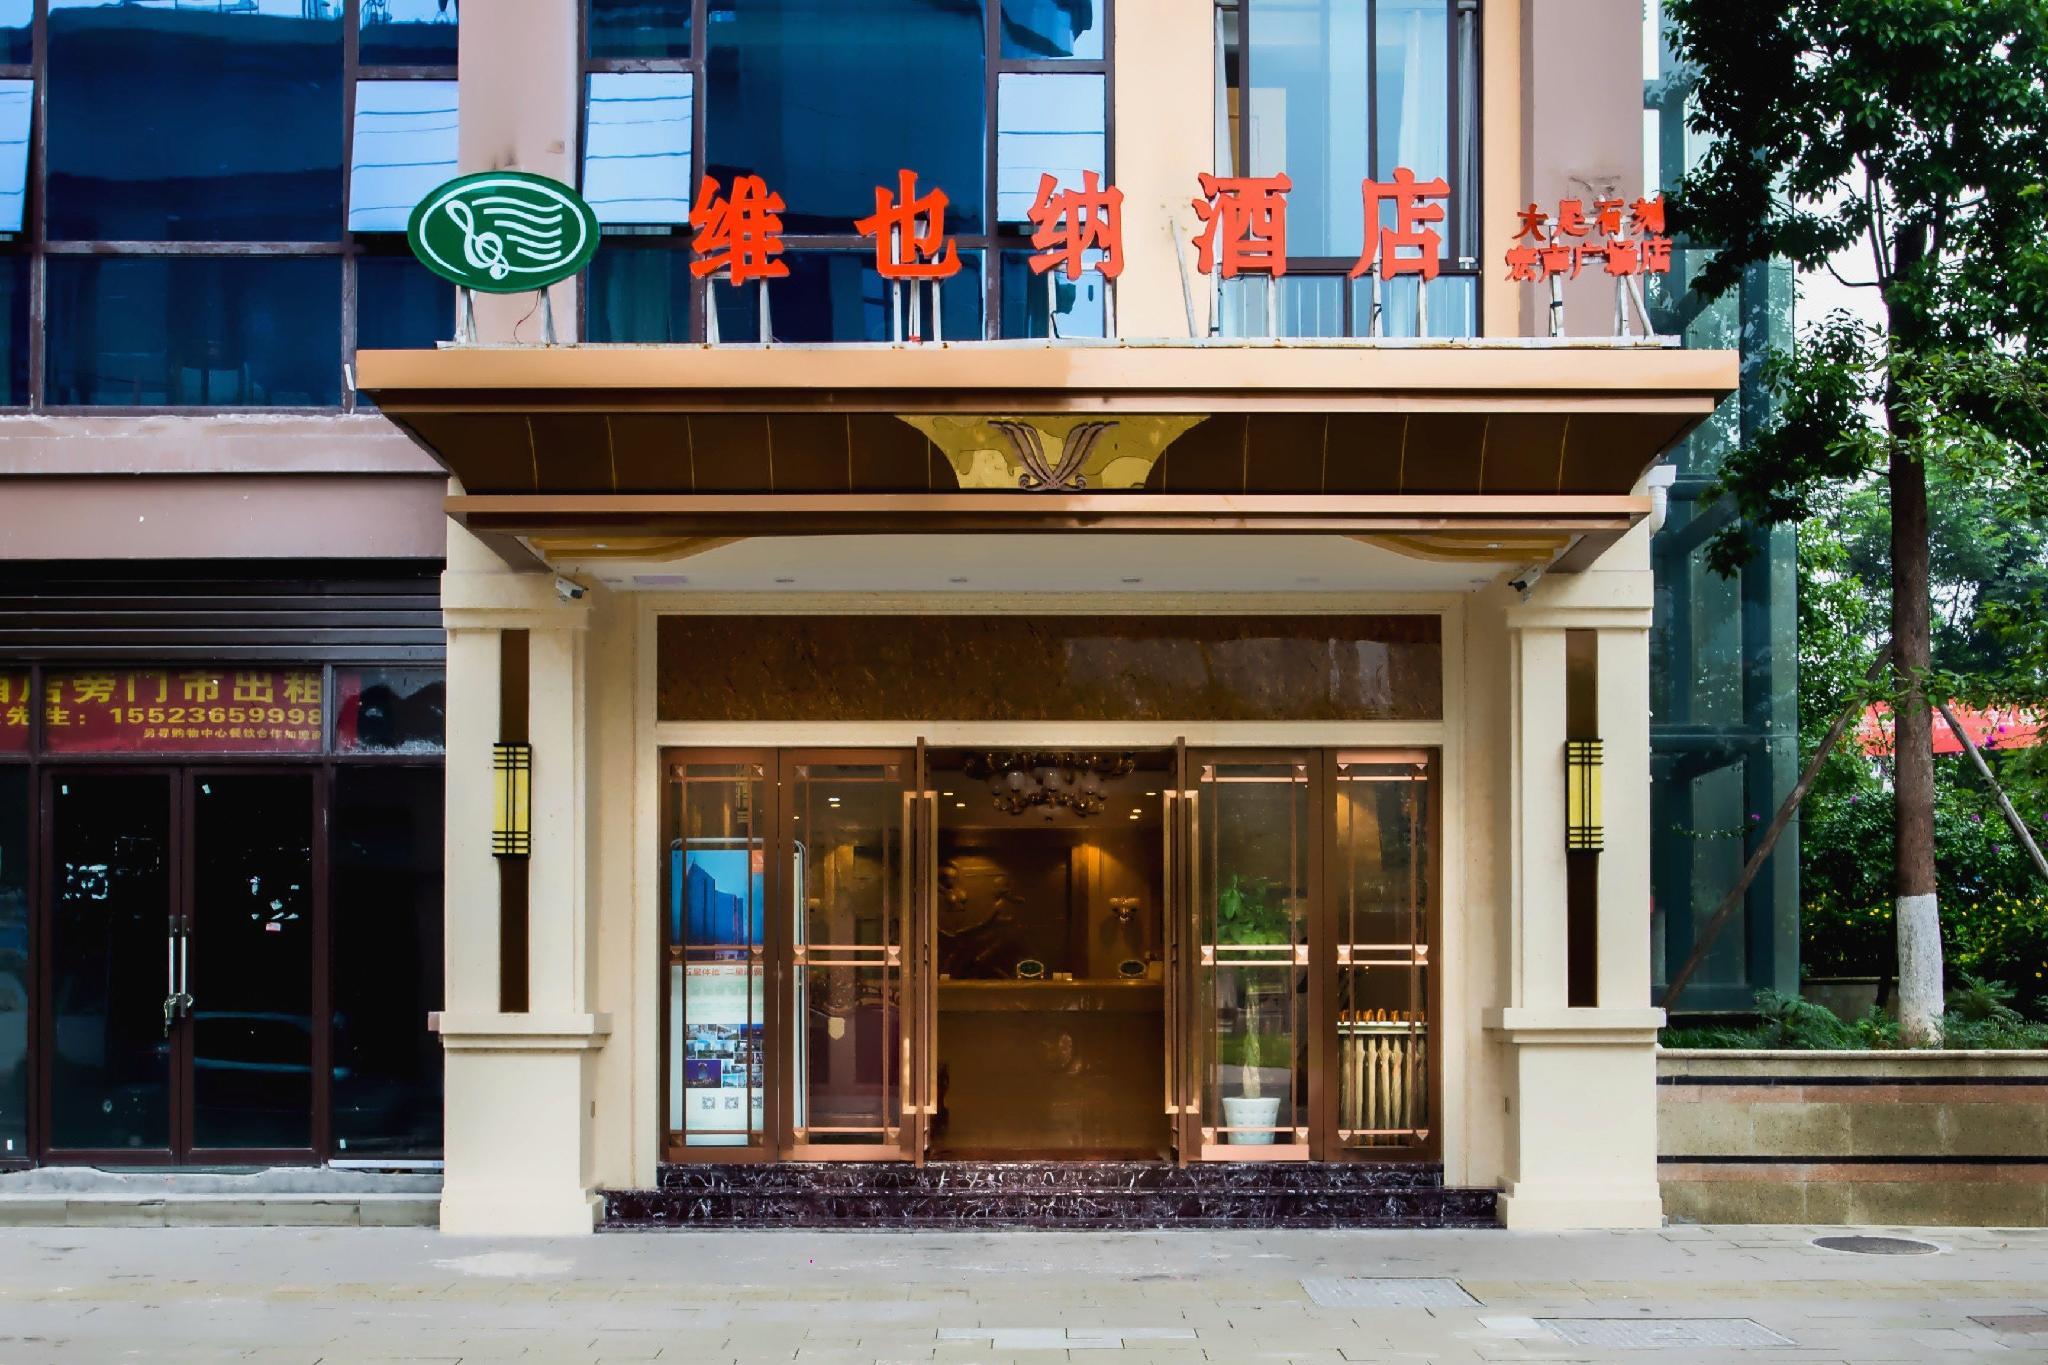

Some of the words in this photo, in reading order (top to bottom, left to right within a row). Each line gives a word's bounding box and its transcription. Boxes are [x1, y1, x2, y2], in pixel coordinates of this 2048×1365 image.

[688, 169, 1451, 286] 维也纳酒店
[1512, 195, 1666, 241] 大足石刻
[0, 672, 321, 704] 店旁门市出租
[110, 707, 321, 726] 15523659998
